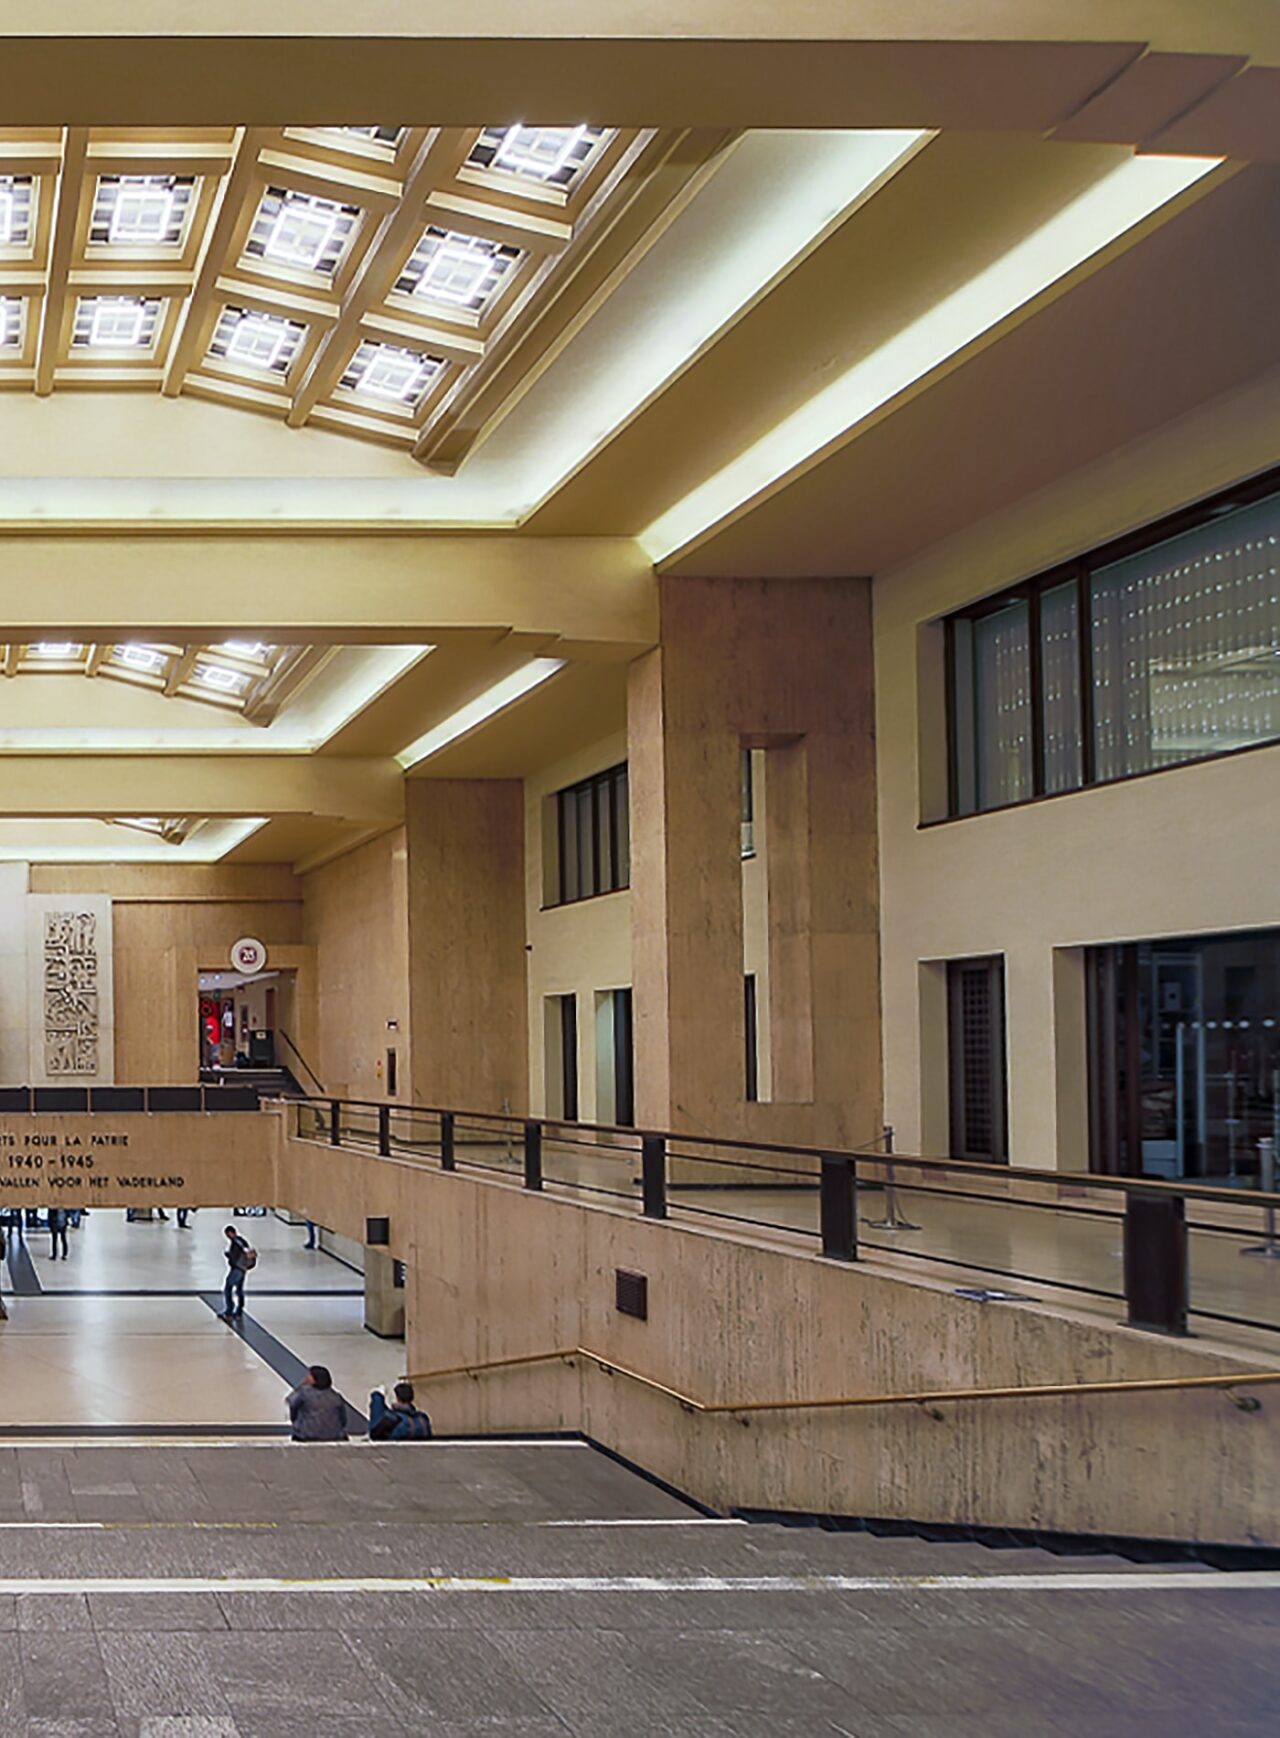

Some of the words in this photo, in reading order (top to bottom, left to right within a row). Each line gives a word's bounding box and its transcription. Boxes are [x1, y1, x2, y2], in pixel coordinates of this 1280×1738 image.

[24, 1135, 57, 1147] POUR
[65, 1135, 81, 1147] LA
[91, 1135, 129, 1147] PATRIE
[8, 1154, 43, 1169] 1940
[60, 1154, 94, 1169] 1945
[47, 1176, 82, 1189] VOOR
[89, 1176, 109, 1189] HET
[116, 1176, 185, 1189] VADERLAND
